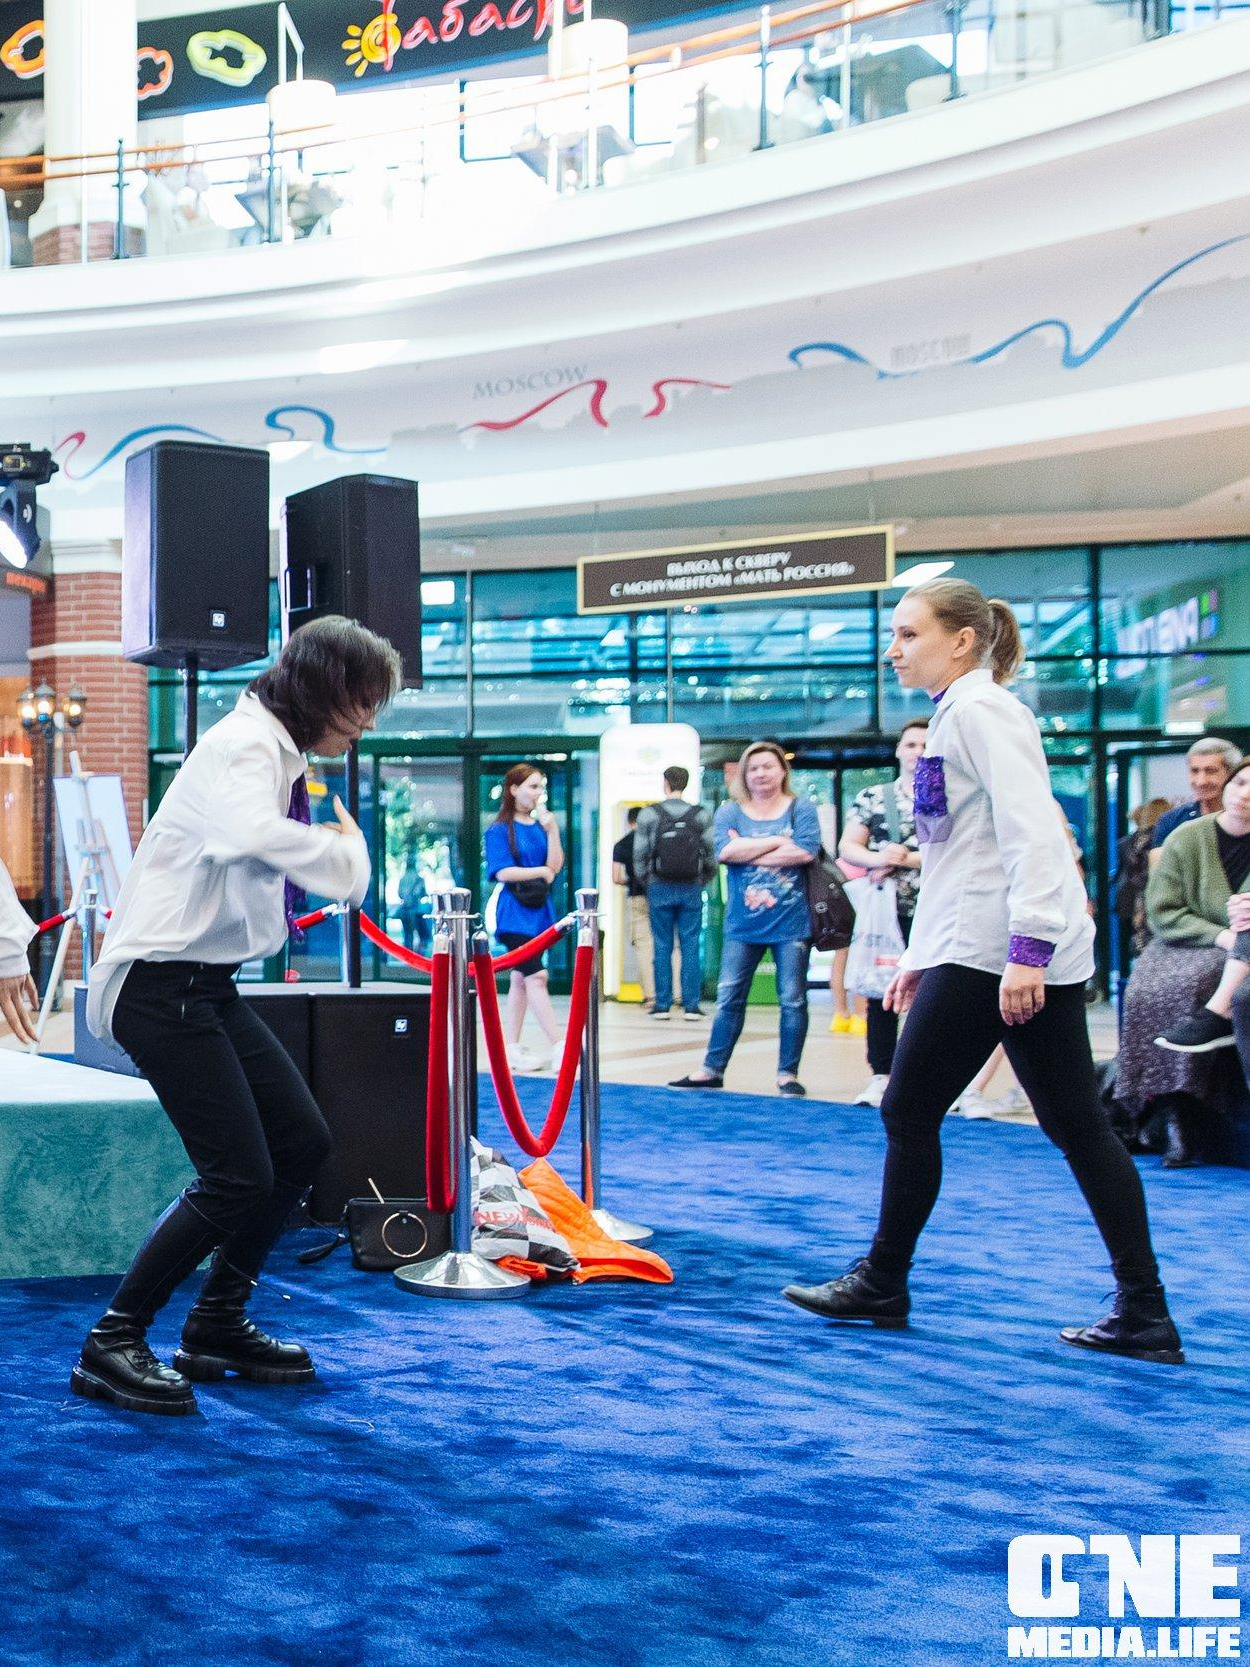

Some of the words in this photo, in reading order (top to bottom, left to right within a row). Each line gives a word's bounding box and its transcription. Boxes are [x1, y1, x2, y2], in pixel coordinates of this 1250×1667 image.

[471, 363, 590, 399] MOSCOW
[666, 559, 721, 577] ВЫХОД
[722, 557, 734, 572] К
[734, 551, 792, 571] СКВЕРУ
[609, 583, 622, 597] С
[622, 573, 732, 596] МОНУМЕНТОМ
